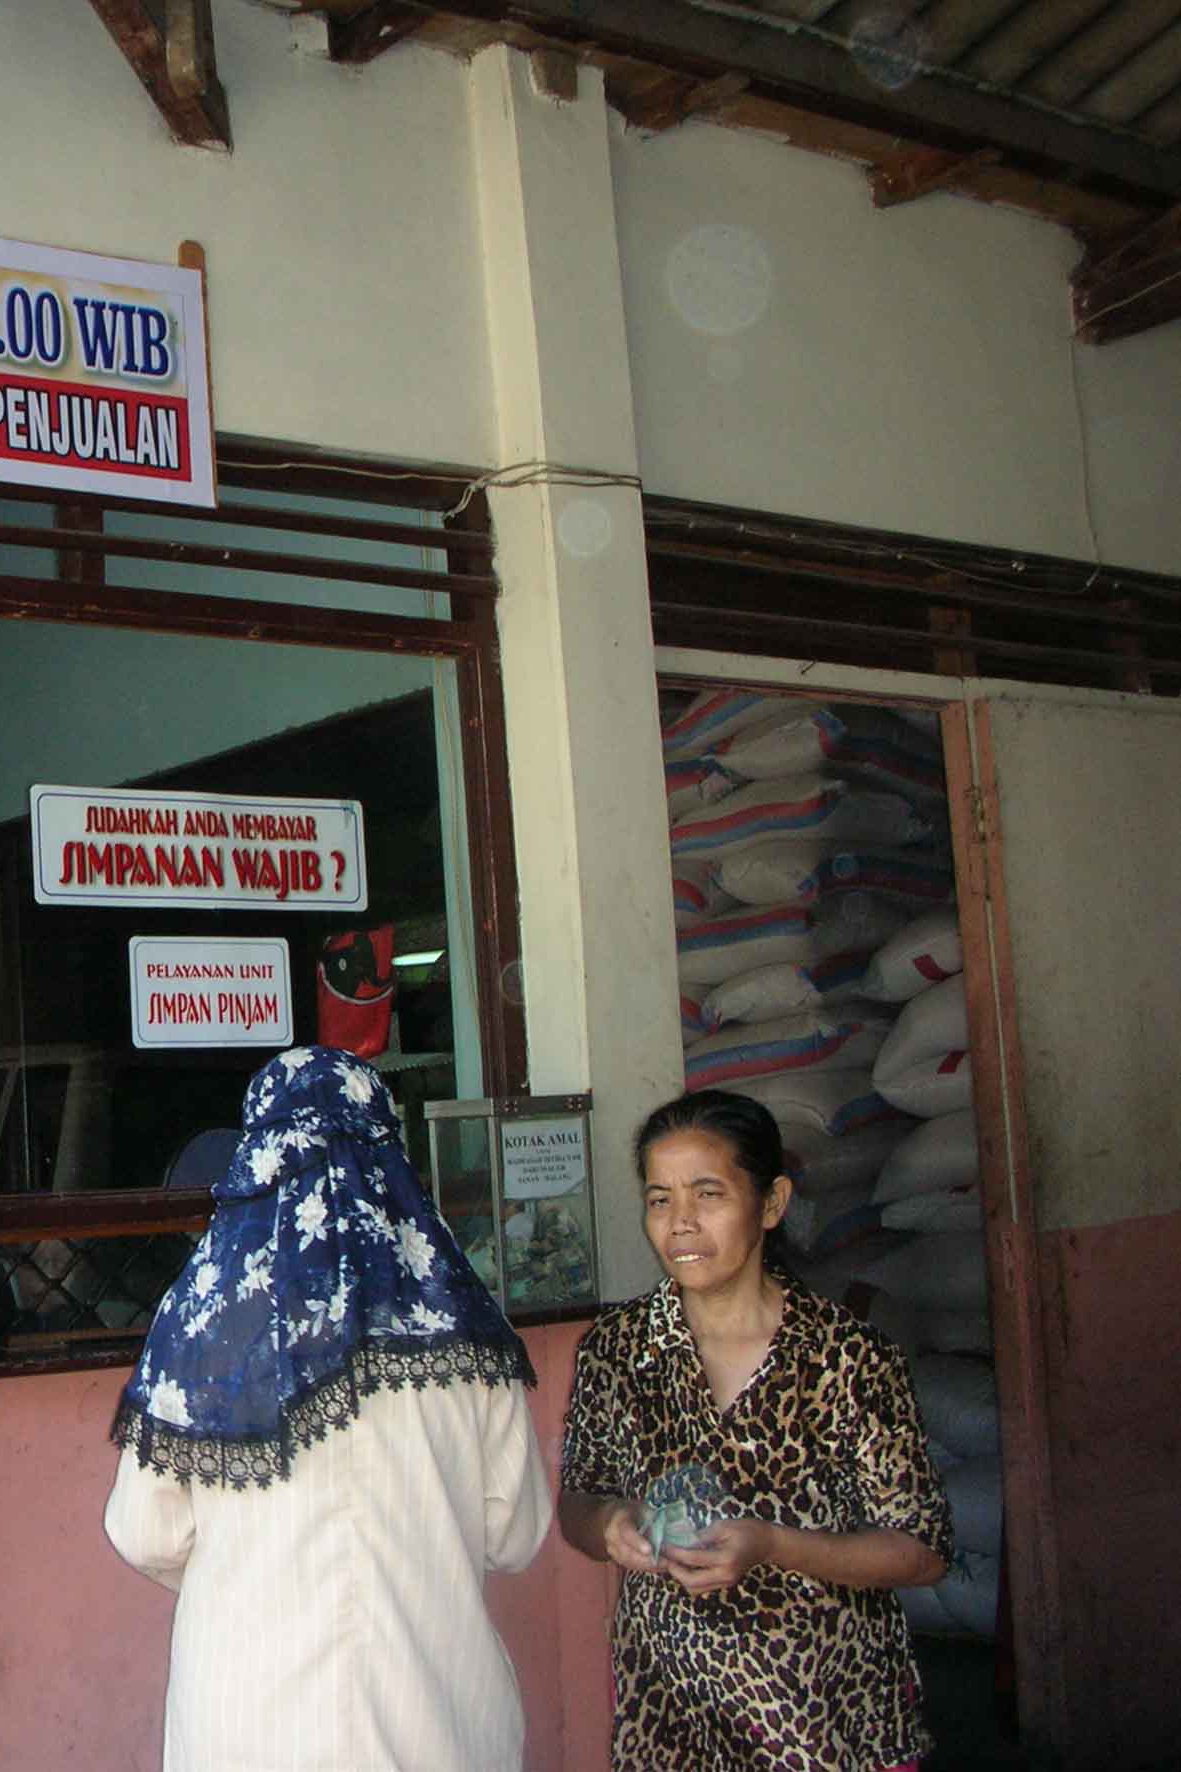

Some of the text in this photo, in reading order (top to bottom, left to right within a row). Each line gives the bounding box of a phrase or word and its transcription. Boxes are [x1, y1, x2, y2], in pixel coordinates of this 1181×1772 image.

[72, 296, 169, 378] WIB
[85, 805, 318, 841] SUDAHKAH ANDA MEMBAYAR
[59, 841, 346, 899] SIMPANAN WAJIB ?
[147, 963, 275, 979] PELAYANAN UNIT
[148, 992, 279, 1031] SIMPAN PINJAM
[505, 1131, 581, 1149] KOTAK AMAL
